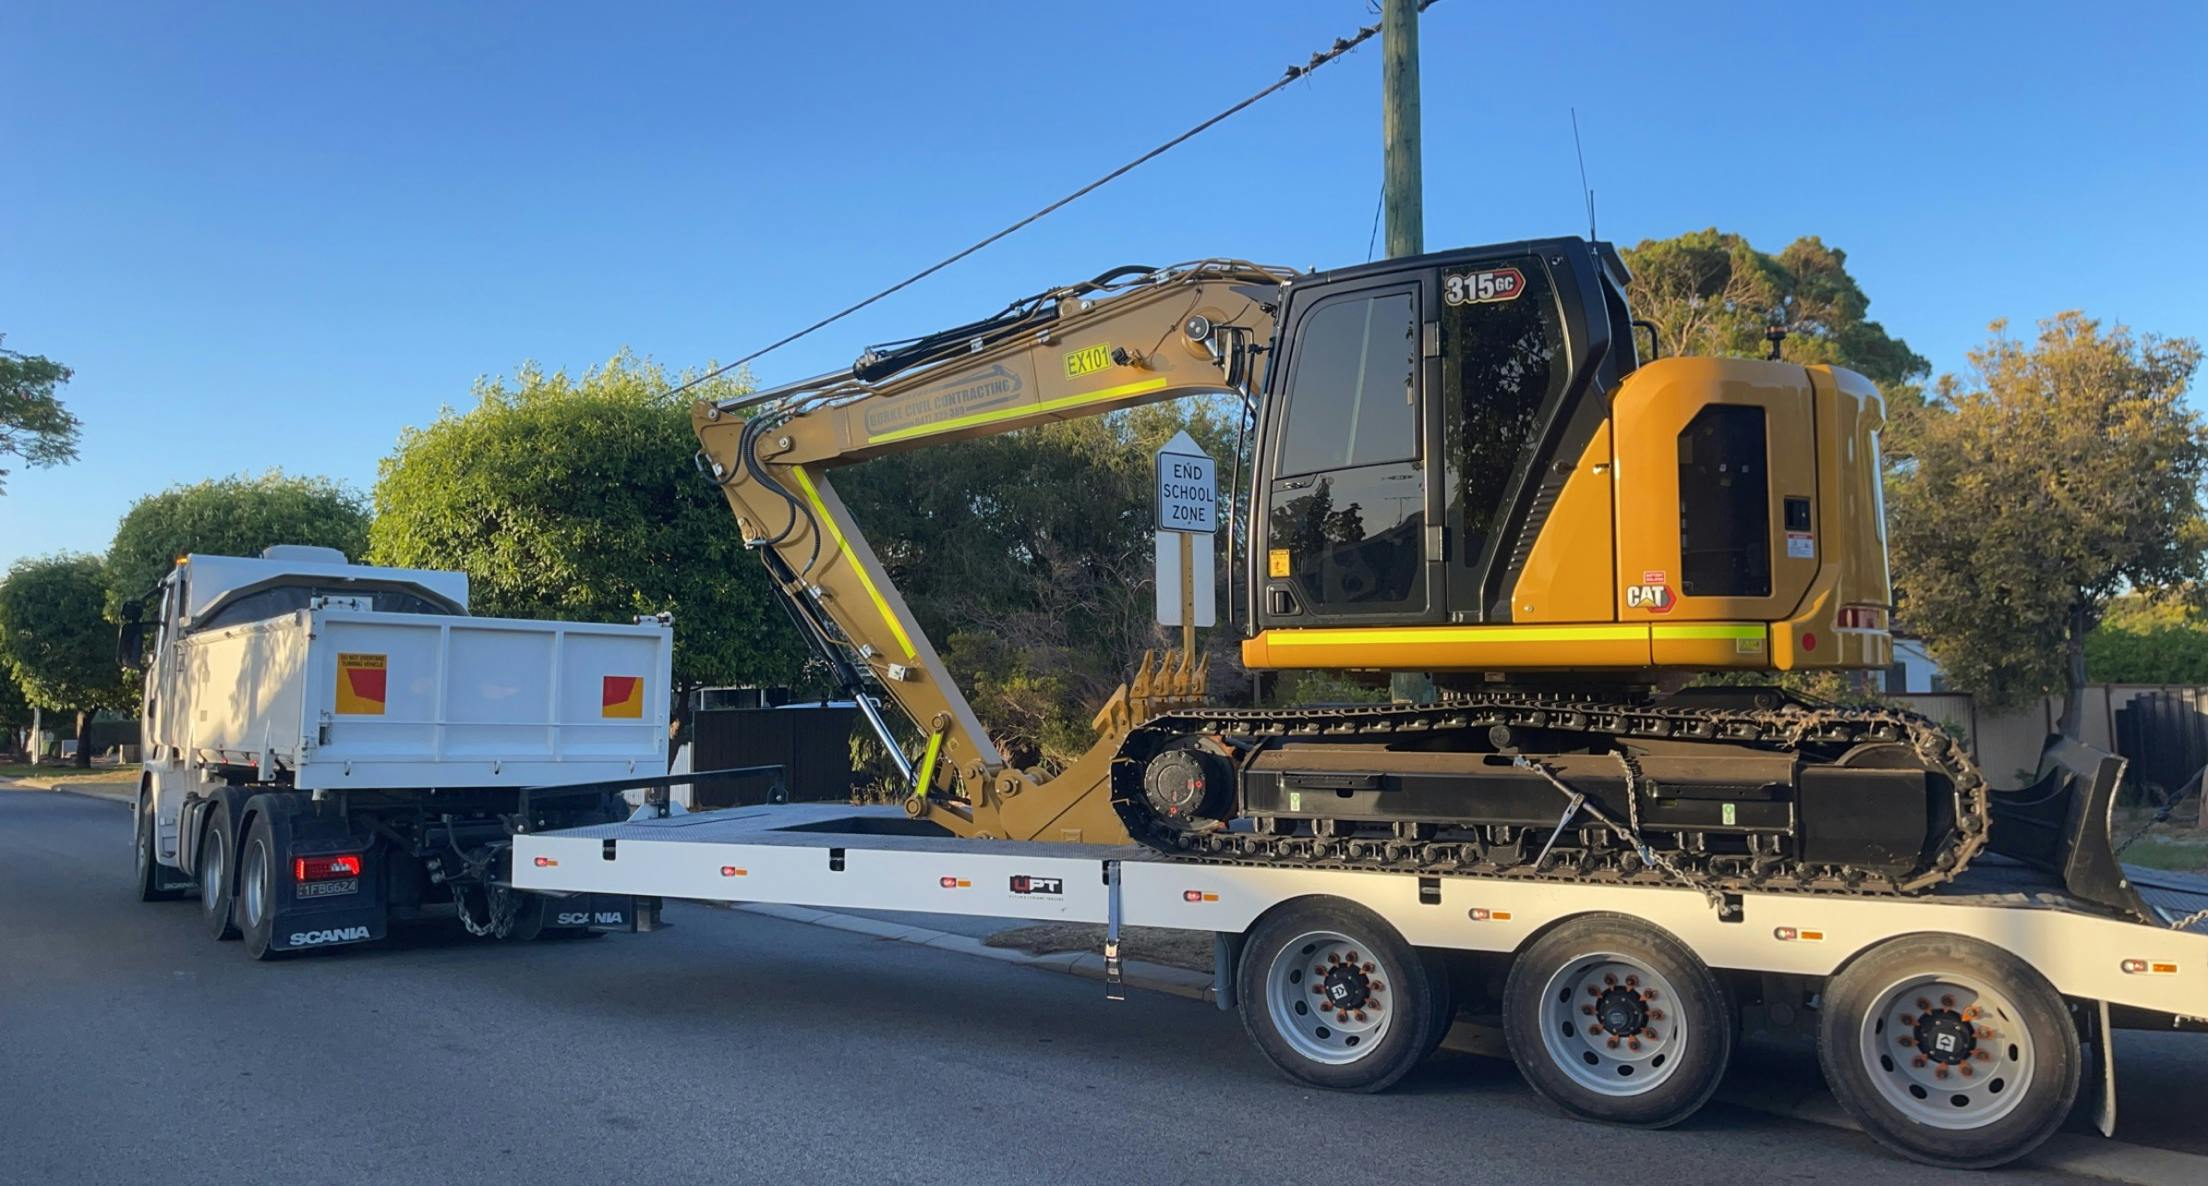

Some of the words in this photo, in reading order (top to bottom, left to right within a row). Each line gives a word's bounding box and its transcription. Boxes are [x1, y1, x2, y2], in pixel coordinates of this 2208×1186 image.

[1067, 346, 1109, 375] EX101
[904, 399, 932, 417] CIVIL
[935, 379, 1009, 409] CONTRACTING
[1173, 464, 1203, 480] END
[1163, 483, 1214, 502] SCHOOL
[1172, 504, 1206, 522] ZONE
[1627, 585, 1664, 608] CAT
[289, 926, 371, 946] SCANIA
